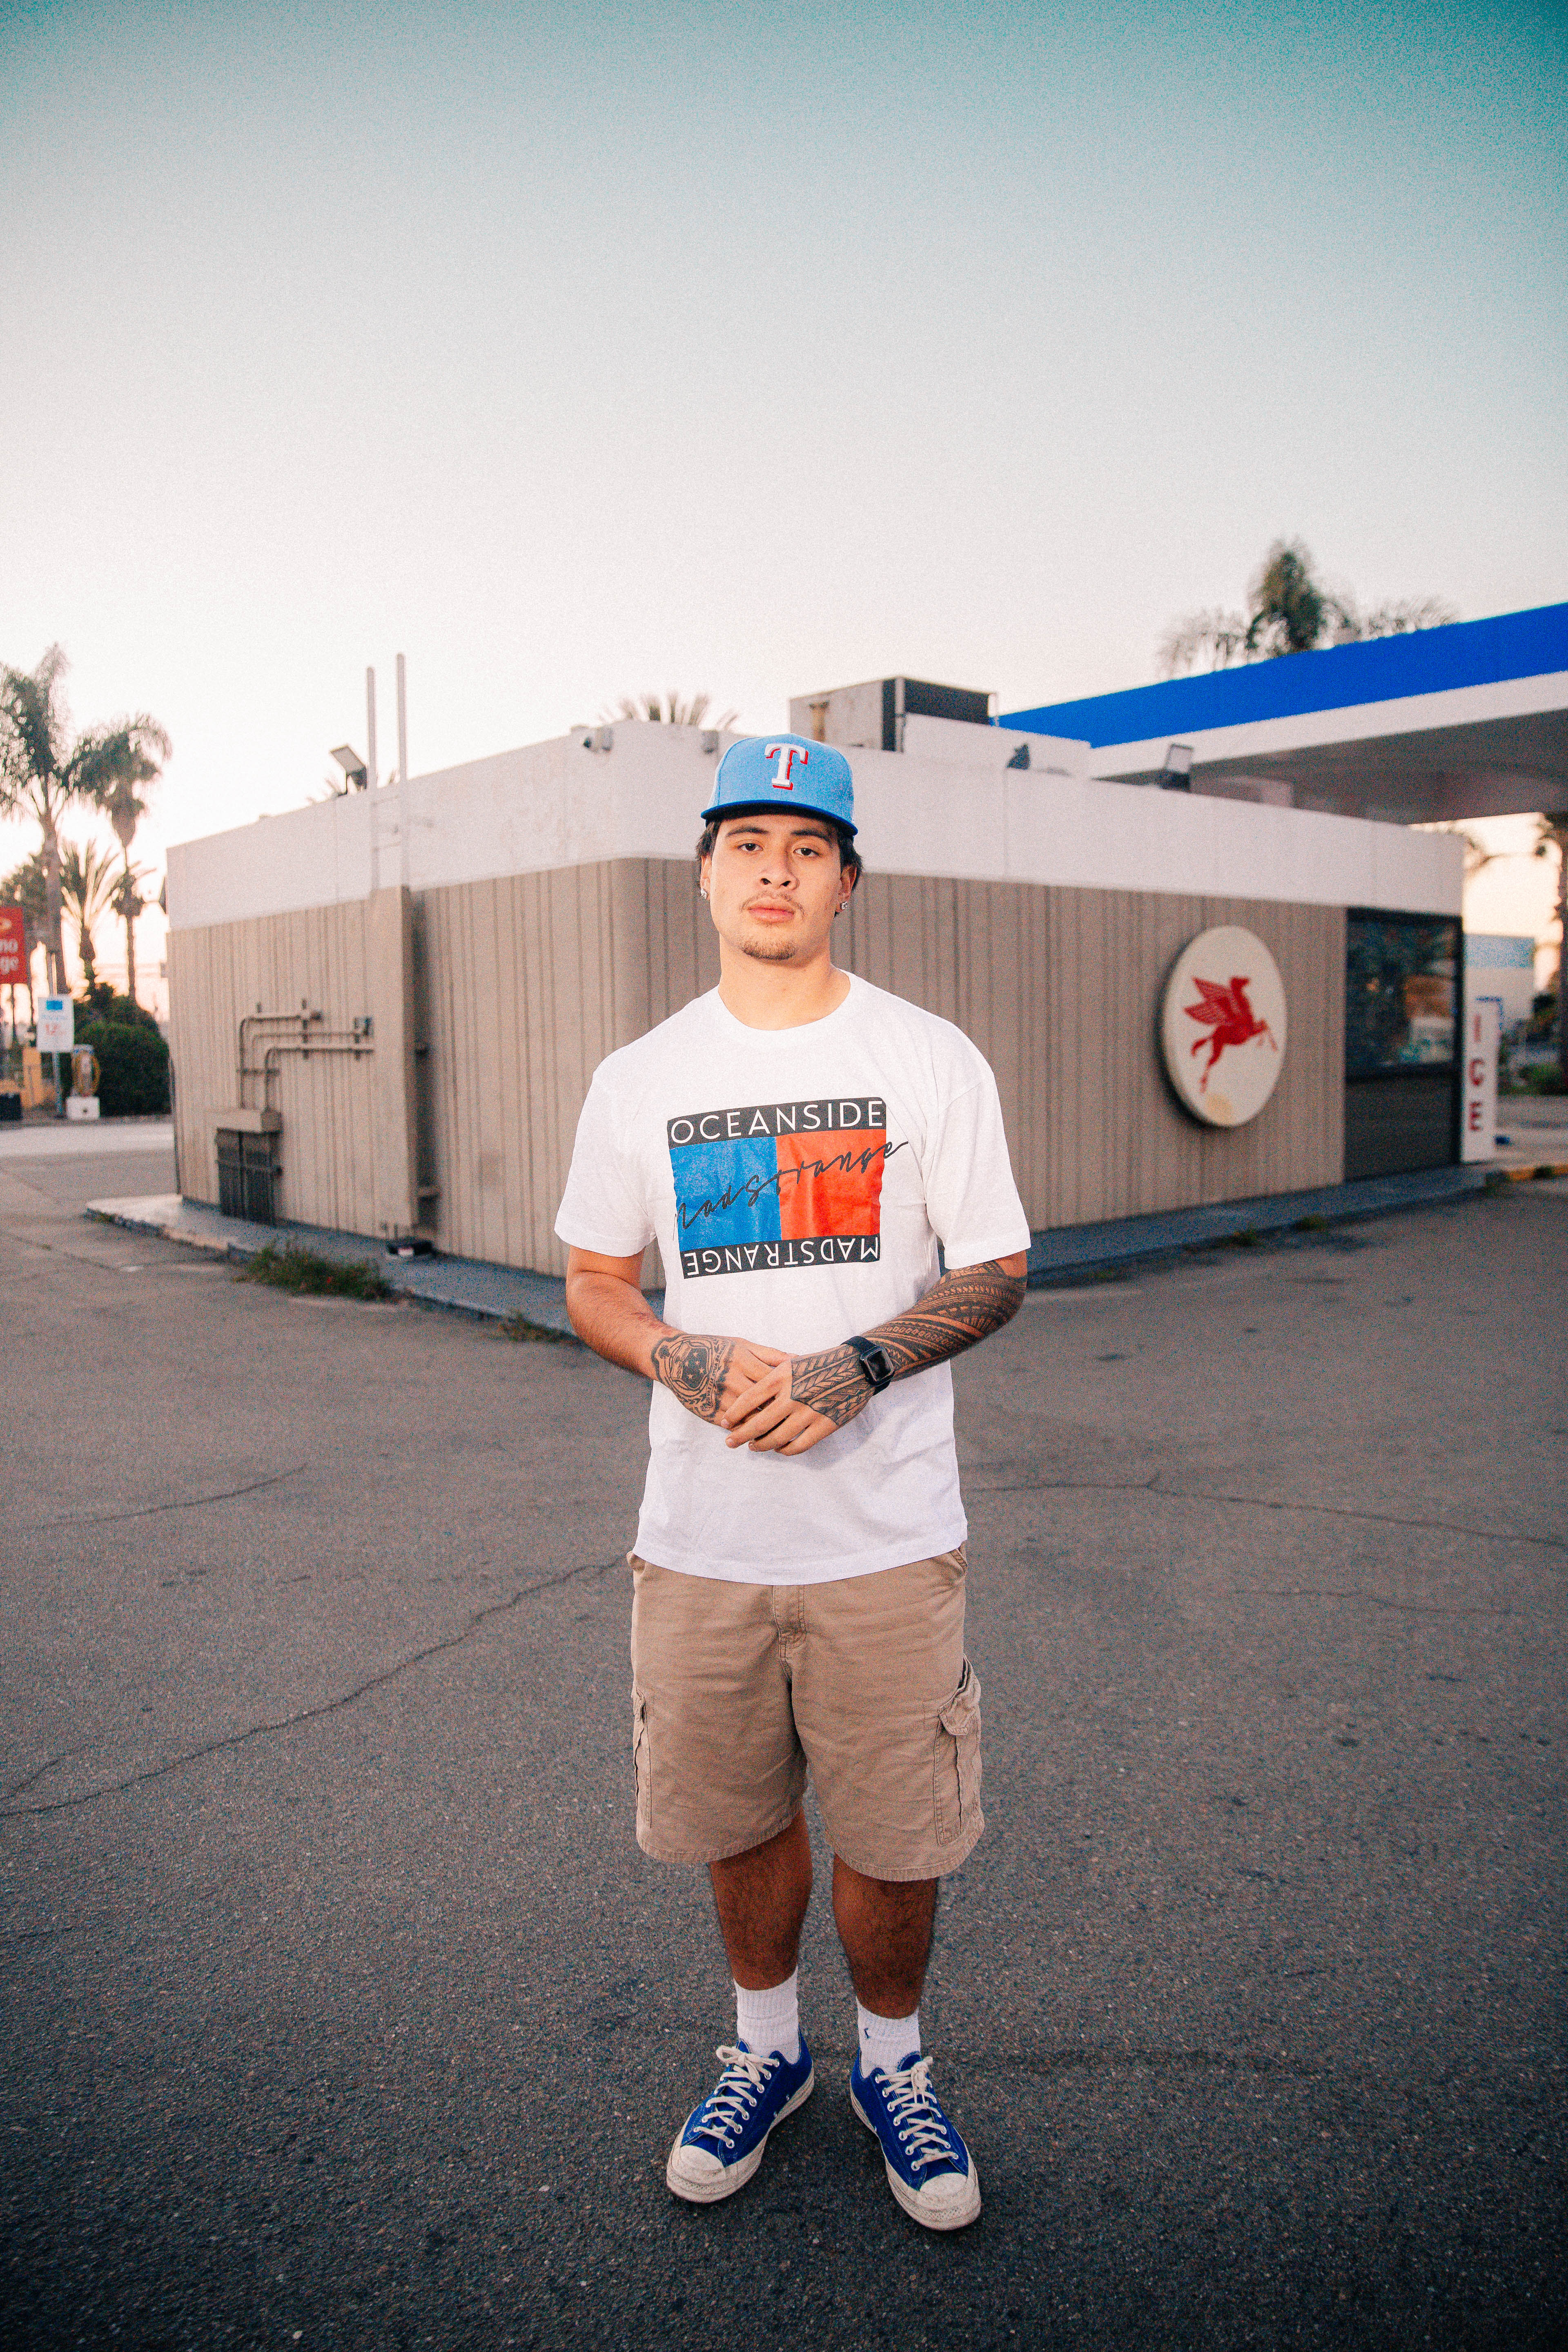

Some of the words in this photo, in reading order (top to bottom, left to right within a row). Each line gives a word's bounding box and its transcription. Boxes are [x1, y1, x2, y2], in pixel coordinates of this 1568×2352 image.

[764, 743, 808, 791] T
[1469, 1013, 1485, 1131] ICE
[670, 1100, 883, 1144] OCEANSIDE
[684, 1236, 878, 1276] MADSTRANGE
